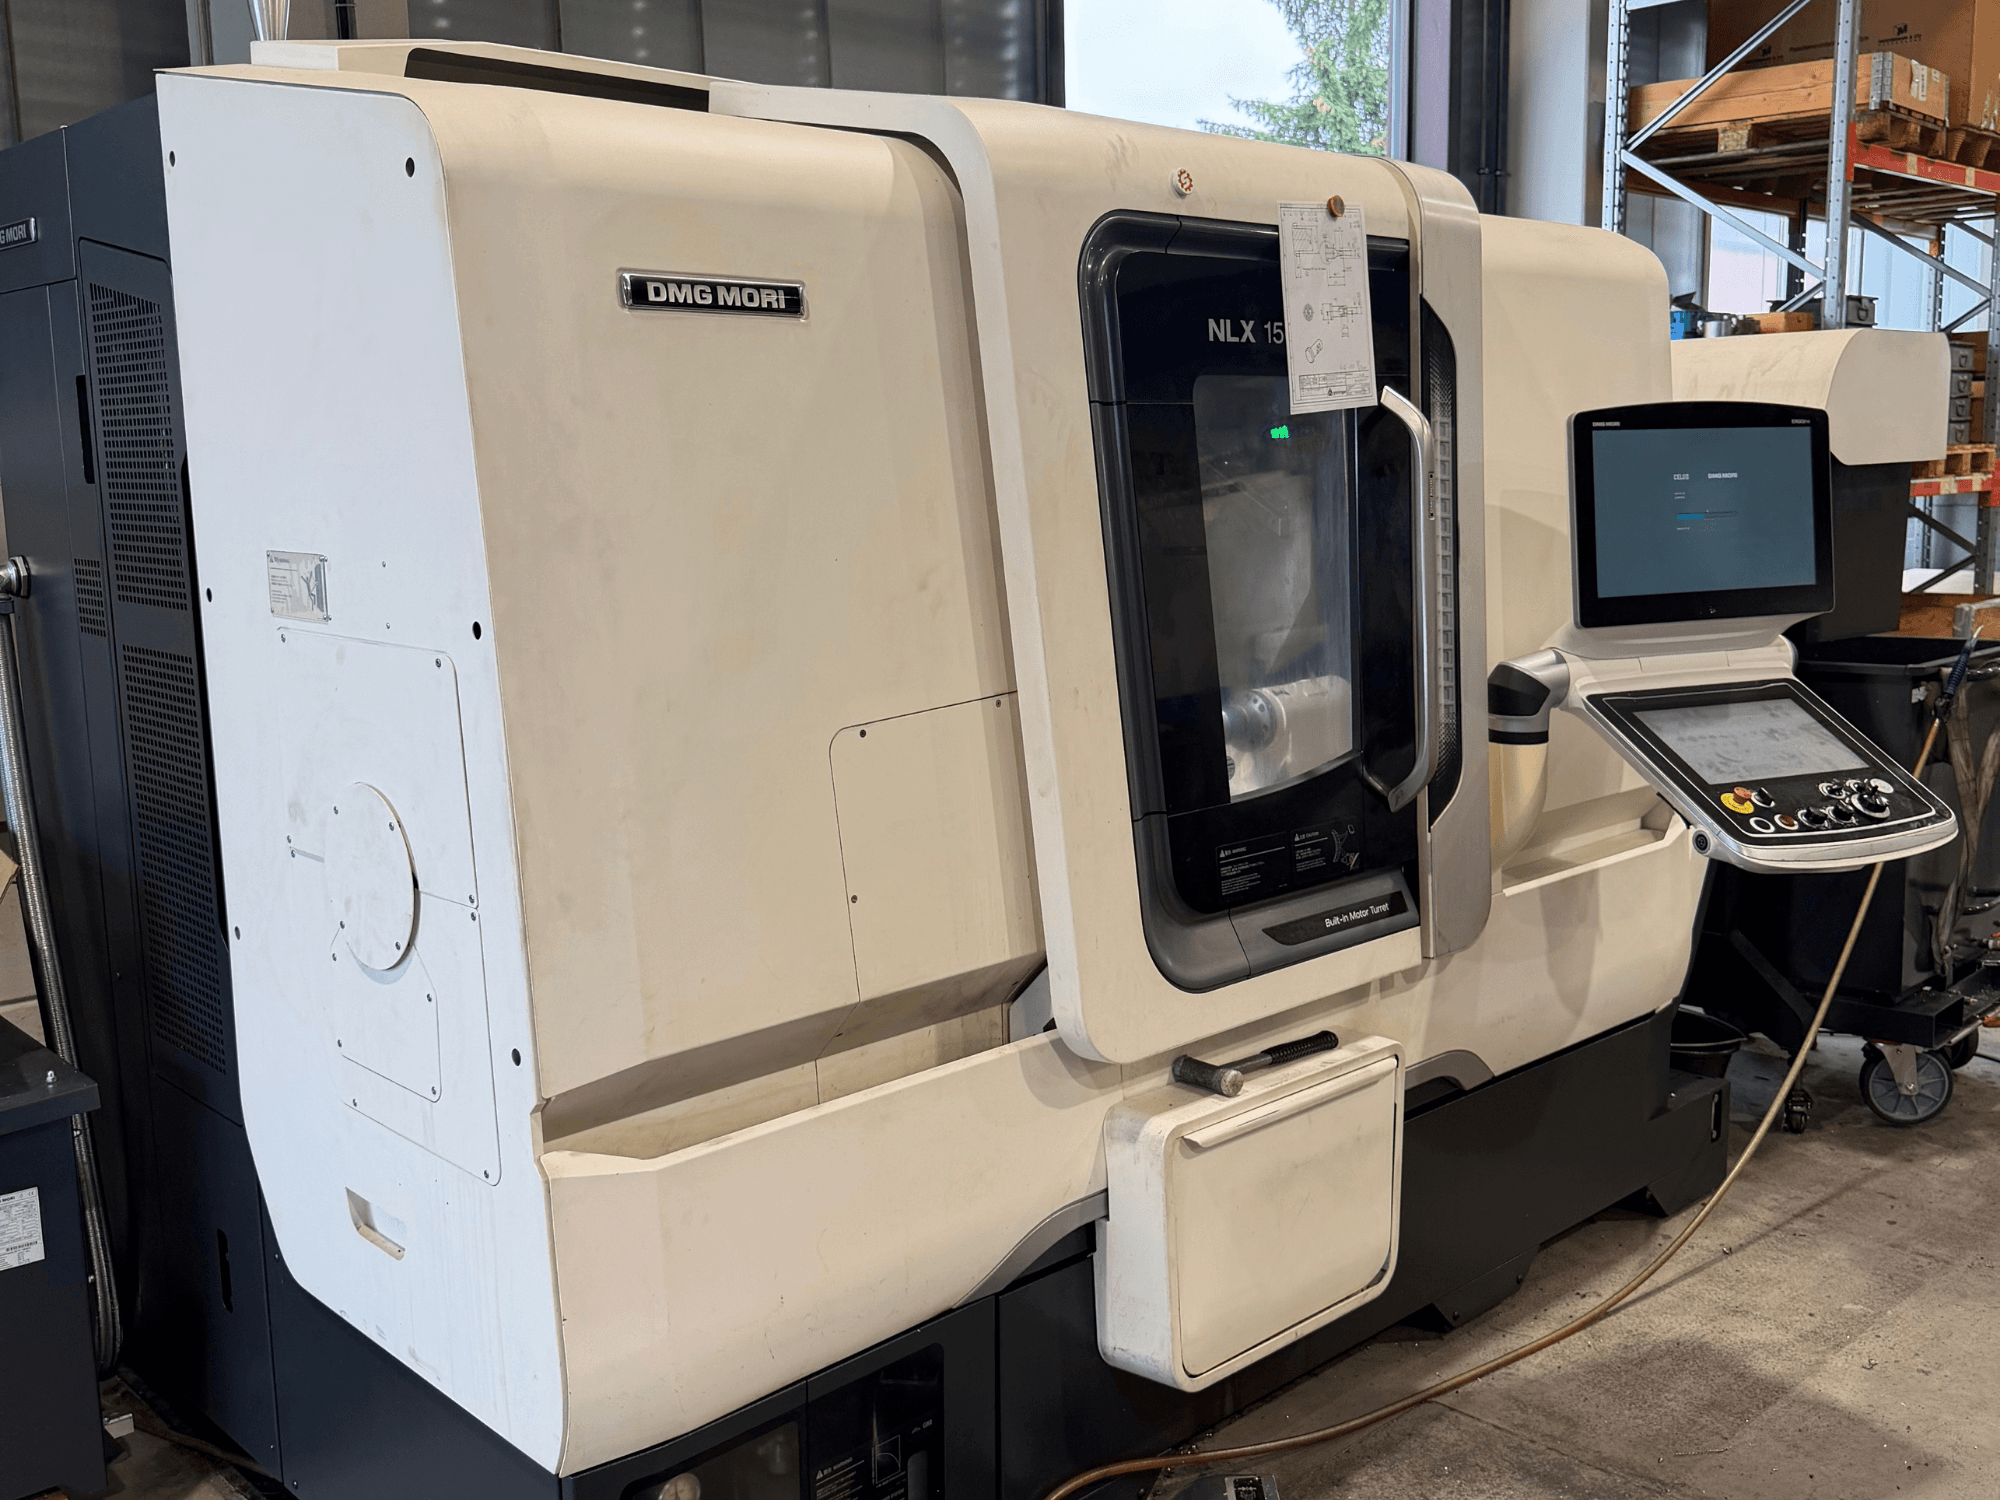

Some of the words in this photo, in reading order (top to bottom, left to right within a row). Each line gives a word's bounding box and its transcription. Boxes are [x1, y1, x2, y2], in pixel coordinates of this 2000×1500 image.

[6, 224, 26, 243] MORI
[646, 281, 713, 305] DMG
[716, 285, 786, 309] MORI
[1208, 318, 1256, 343] NLX
[1263, 320, 1284, 344] 15
[1324, 914, 1350, 928] Built-in
[1348, 908, 1369, 921] Motor
[1368, 902, 1390, 915] Turret
